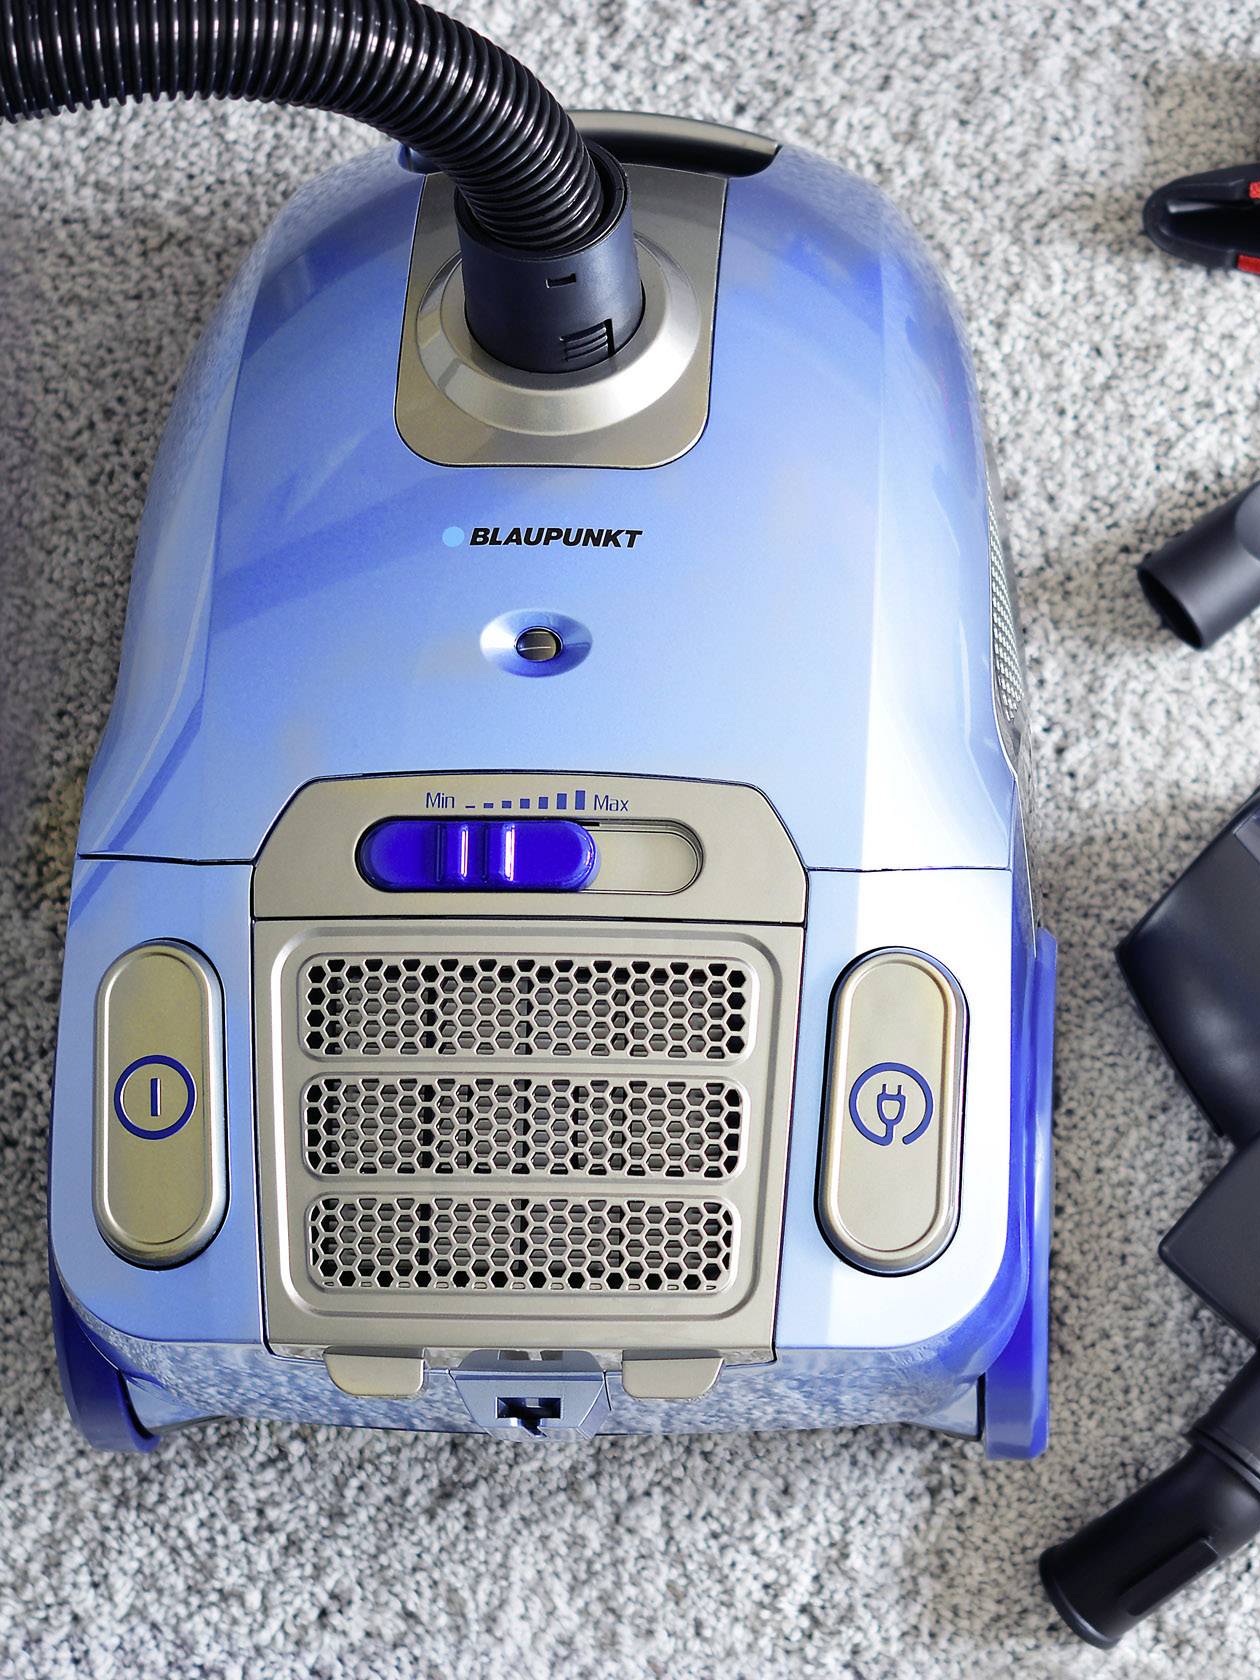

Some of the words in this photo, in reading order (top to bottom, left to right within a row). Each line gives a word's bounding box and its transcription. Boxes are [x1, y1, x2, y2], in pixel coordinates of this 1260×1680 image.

[469, 527, 643, 548] BLAUPUNKT
[425, 792, 455, 809] Min
[593, 794, 629, 812] Max
